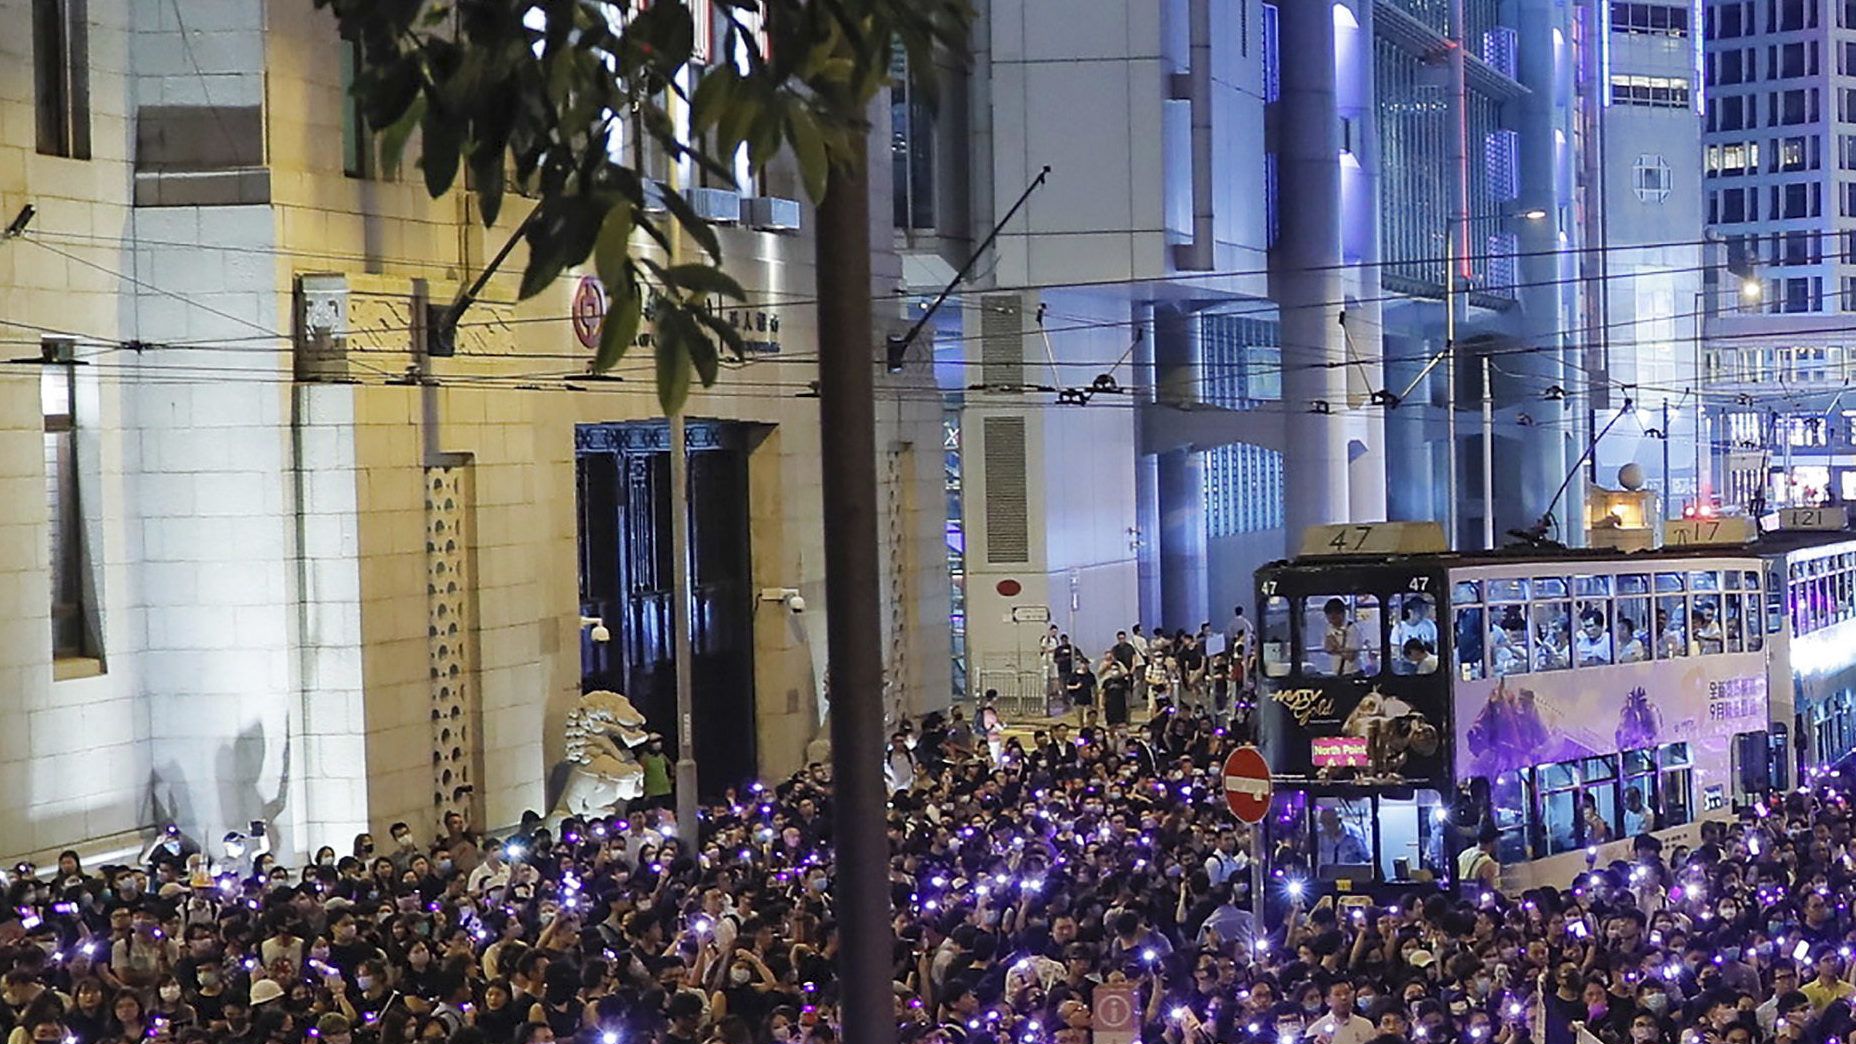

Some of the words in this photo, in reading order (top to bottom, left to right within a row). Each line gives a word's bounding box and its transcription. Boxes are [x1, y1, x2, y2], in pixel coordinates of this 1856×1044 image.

[1790, 510, 1823, 526] 121
[1328, 526, 1372, 552] 47
[1260, 580, 1279, 595] 47
[1408, 576, 1430, 591] 47
[1313, 745, 1341, 756] North
[1343, 745, 1367, 755] Point
